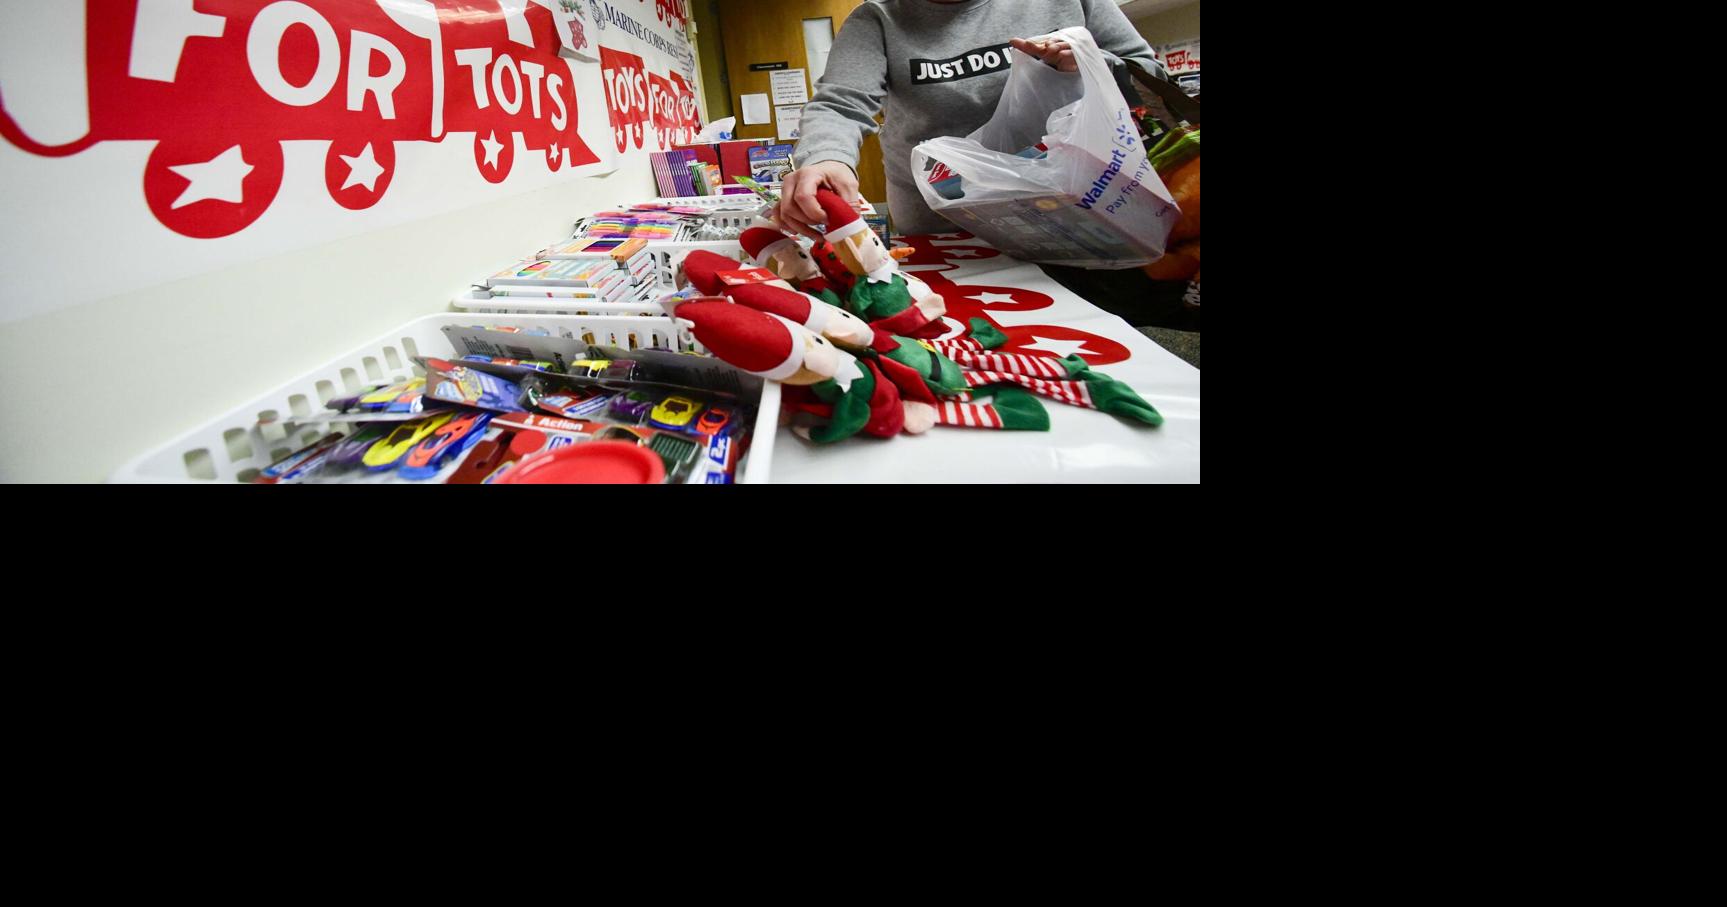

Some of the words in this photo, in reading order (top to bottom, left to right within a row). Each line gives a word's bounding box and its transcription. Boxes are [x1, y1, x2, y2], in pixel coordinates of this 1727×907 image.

[605, 3, 644, 41] MARINE
[644, 27, 667, 53] CORPS
[455, 47, 568, 132] TOTS
[917, 59, 965, 81] JUST
[968, 51, 1001, 72] DO
[604, 67, 646, 115] TOYS
[651, 84, 675, 123] FOR
[1075, 149, 1126, 212] Walmart
[1106, 193, 1128, 215] Pay
[1123, 166, 1145, 198] from
[538, 416, 584, 432] Action
